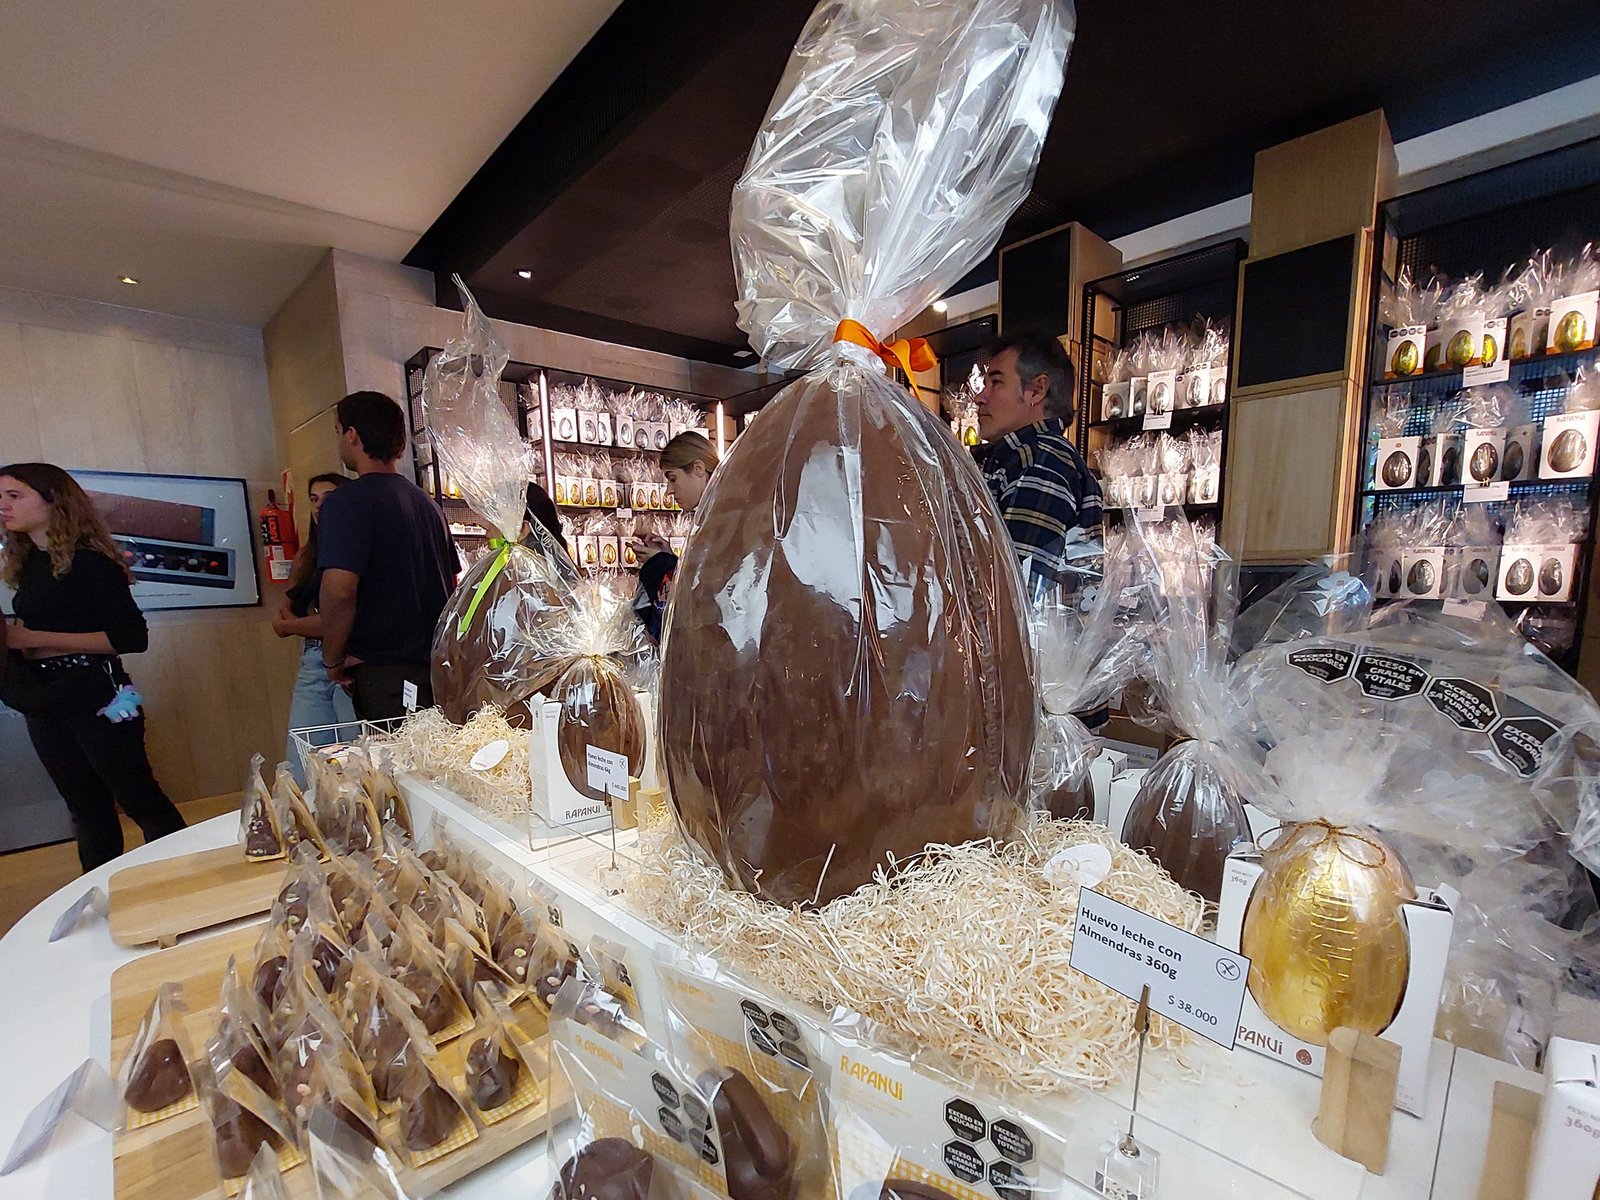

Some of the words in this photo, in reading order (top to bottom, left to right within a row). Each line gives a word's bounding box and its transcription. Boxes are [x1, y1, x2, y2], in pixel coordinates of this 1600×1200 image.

[1335, 653, 1349, 664] EN
[1365, 657, 1407, 672] EXCESO
[1408, 668, 1424, 678] EN
[1364, 674, 1411, 691] TOTALES
[1369, 667, 1413, 683] GRASAS
[1439, 680, 1480, 705] EXCESO
[1478, 702, 1494, 717] EN
[1444, 689, 1482, 717] GRASAS
[1428, 691, 1486, 730] SATURADAS
[1081, 907, 1119, 933] Huevo
[1121, 921, 1155, 949] leche
[1158, 944, 1182, 962] con
[1078, 923, 1143, 962] Almendras
[1145, 955, 1178, 981] 360g
[1167, 994, 1175, 1006] $
[1177, 999, 1218, 1027] 38.000
[948, 1107, 974, 1123] EXCESO
[973, 1118, 984, 1128] EN
[993, 1124, 1020, 1141] EXCESO
[997, 1133, 1026, 1151] GRASAS
[946, 1146, 973, 1162] EXCESO
[971, 1157, 983, 1167] EN
[996, 1138, 1027, 1157] TOTALES
[945, 1157, 984, 1179] SATURADAS
[951, 1154, 978, 1170] GRASAS
